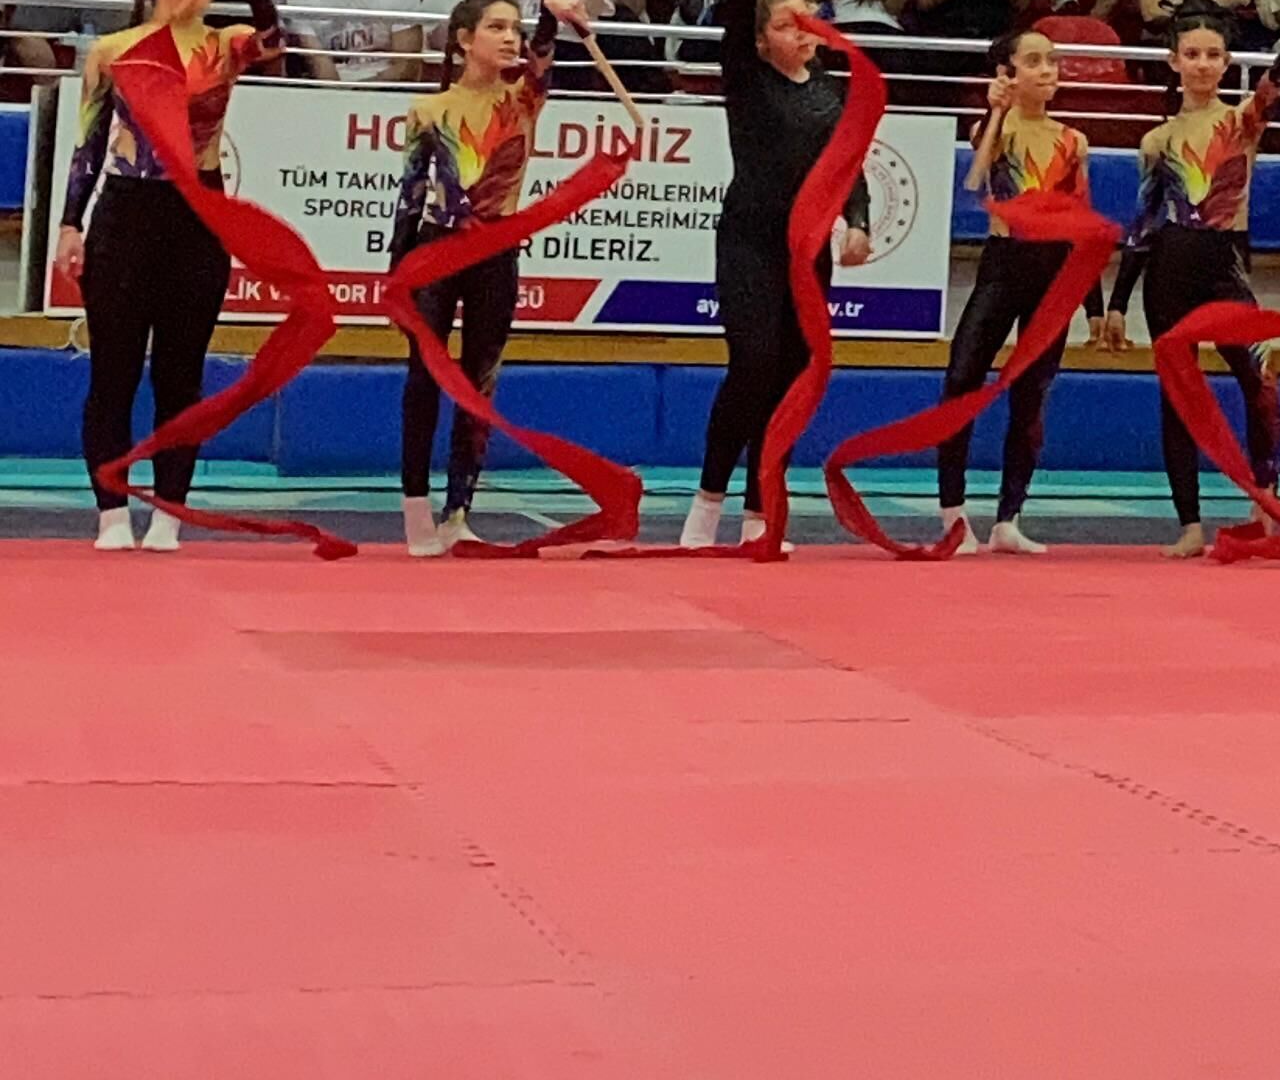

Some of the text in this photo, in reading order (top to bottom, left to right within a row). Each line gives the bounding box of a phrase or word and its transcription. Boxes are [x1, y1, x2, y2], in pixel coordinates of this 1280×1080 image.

[347, 113, 692, 163] HO LDİNİZ
[279, 165, 327, 188] TÜM
[336, 171, 402, 191] TAKIM
[304, 198, 394, 219] SPORCU
